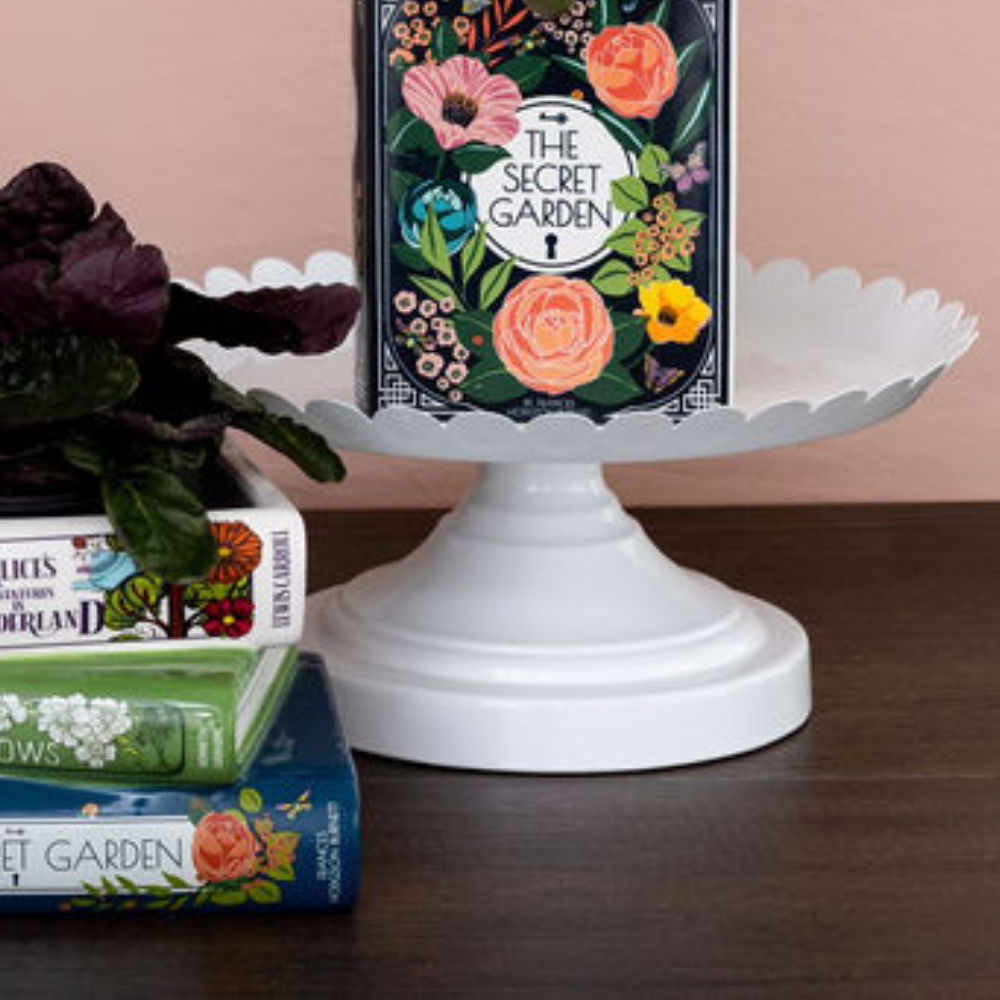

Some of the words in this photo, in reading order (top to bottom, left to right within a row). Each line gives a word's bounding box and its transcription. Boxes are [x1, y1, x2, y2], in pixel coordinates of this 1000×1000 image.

[525, 129, 578, 160] THE
[503, 162, 602, 194] SECRET
[489, 197, 613, 229] GARDEN
[44, 839, 183, 871] GARDEN
